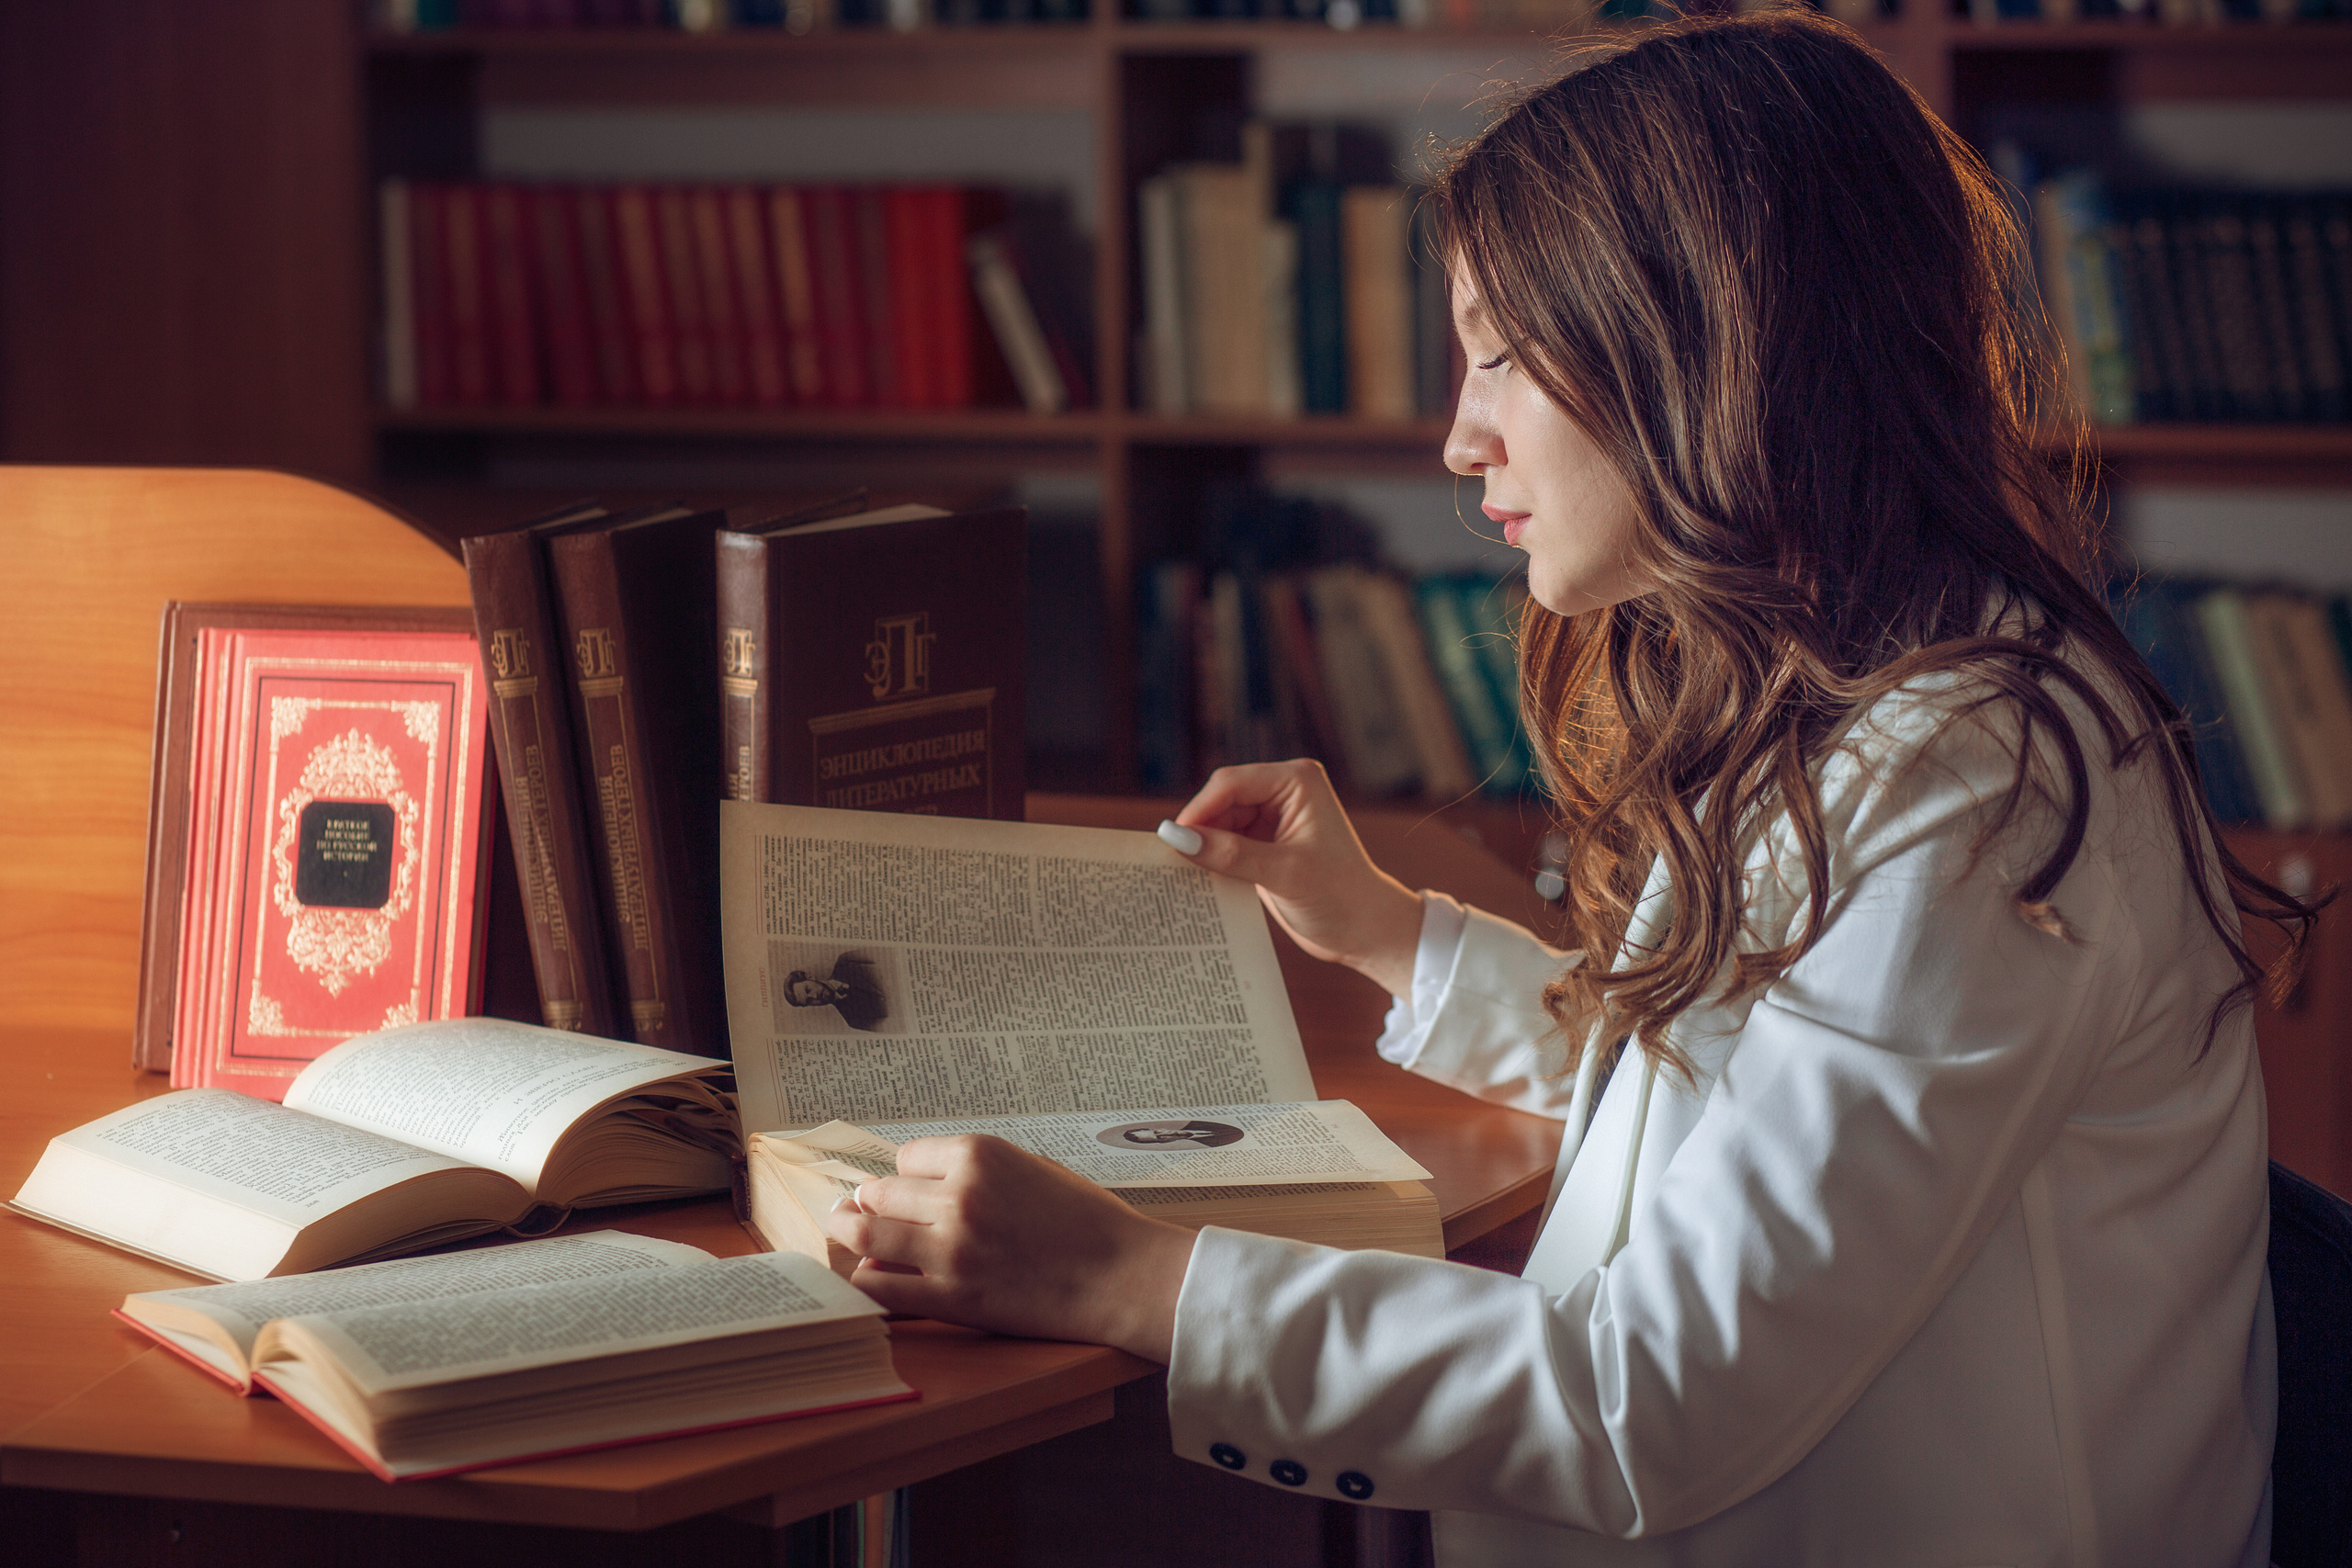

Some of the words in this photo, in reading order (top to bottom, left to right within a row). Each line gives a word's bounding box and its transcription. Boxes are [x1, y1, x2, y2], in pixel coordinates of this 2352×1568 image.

[820, 729, 984, 780] ЭНЦИКЛОПЕДИЯ
[827, 761, 981, 808] ЛИТЕРАТУРНЫХ
[327, 818, 370, 830] КРАТКОЕ
[514, 775, 548, 923] ЭНЦИКЛОПЕДИЯ
[598, 774, 631, 923] ЭНЦИКЛОПЕДИЯ
